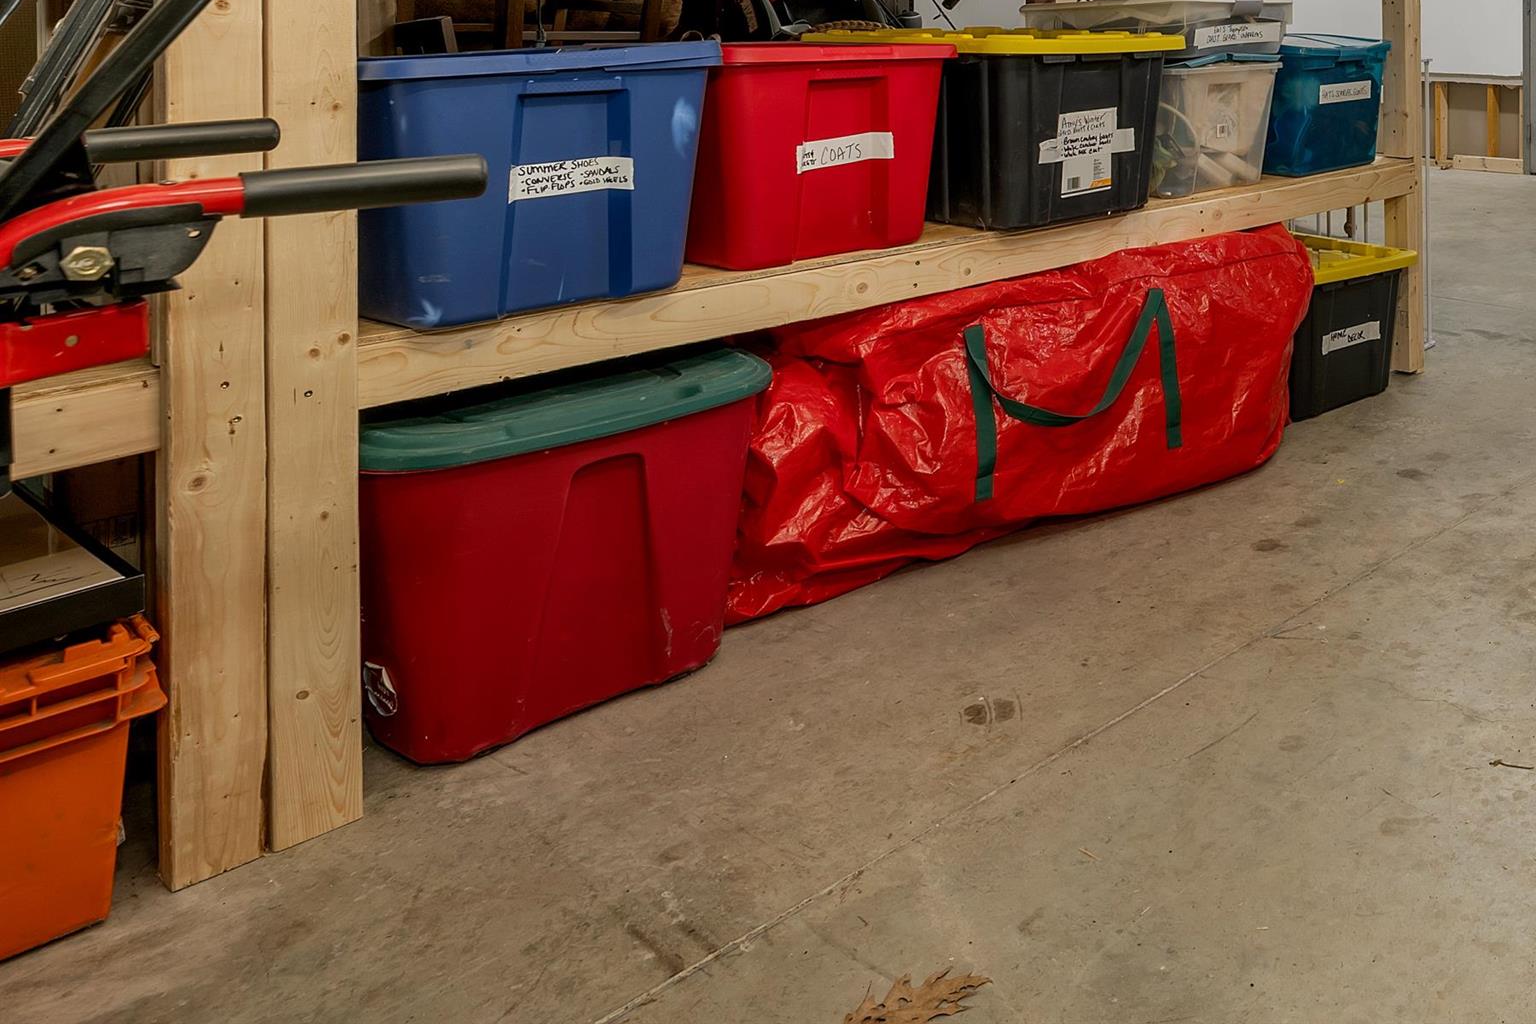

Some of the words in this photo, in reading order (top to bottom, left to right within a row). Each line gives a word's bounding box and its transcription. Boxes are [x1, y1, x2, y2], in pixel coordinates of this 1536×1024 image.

[820, 141, 862, 166] COATS
[517, 160, 567, 177] SUMMER
[570, 157, 600, 170] SHOES
[524, 170, 575, 186] CONVERSE
[583, 165, 620, 178] SANDALS
